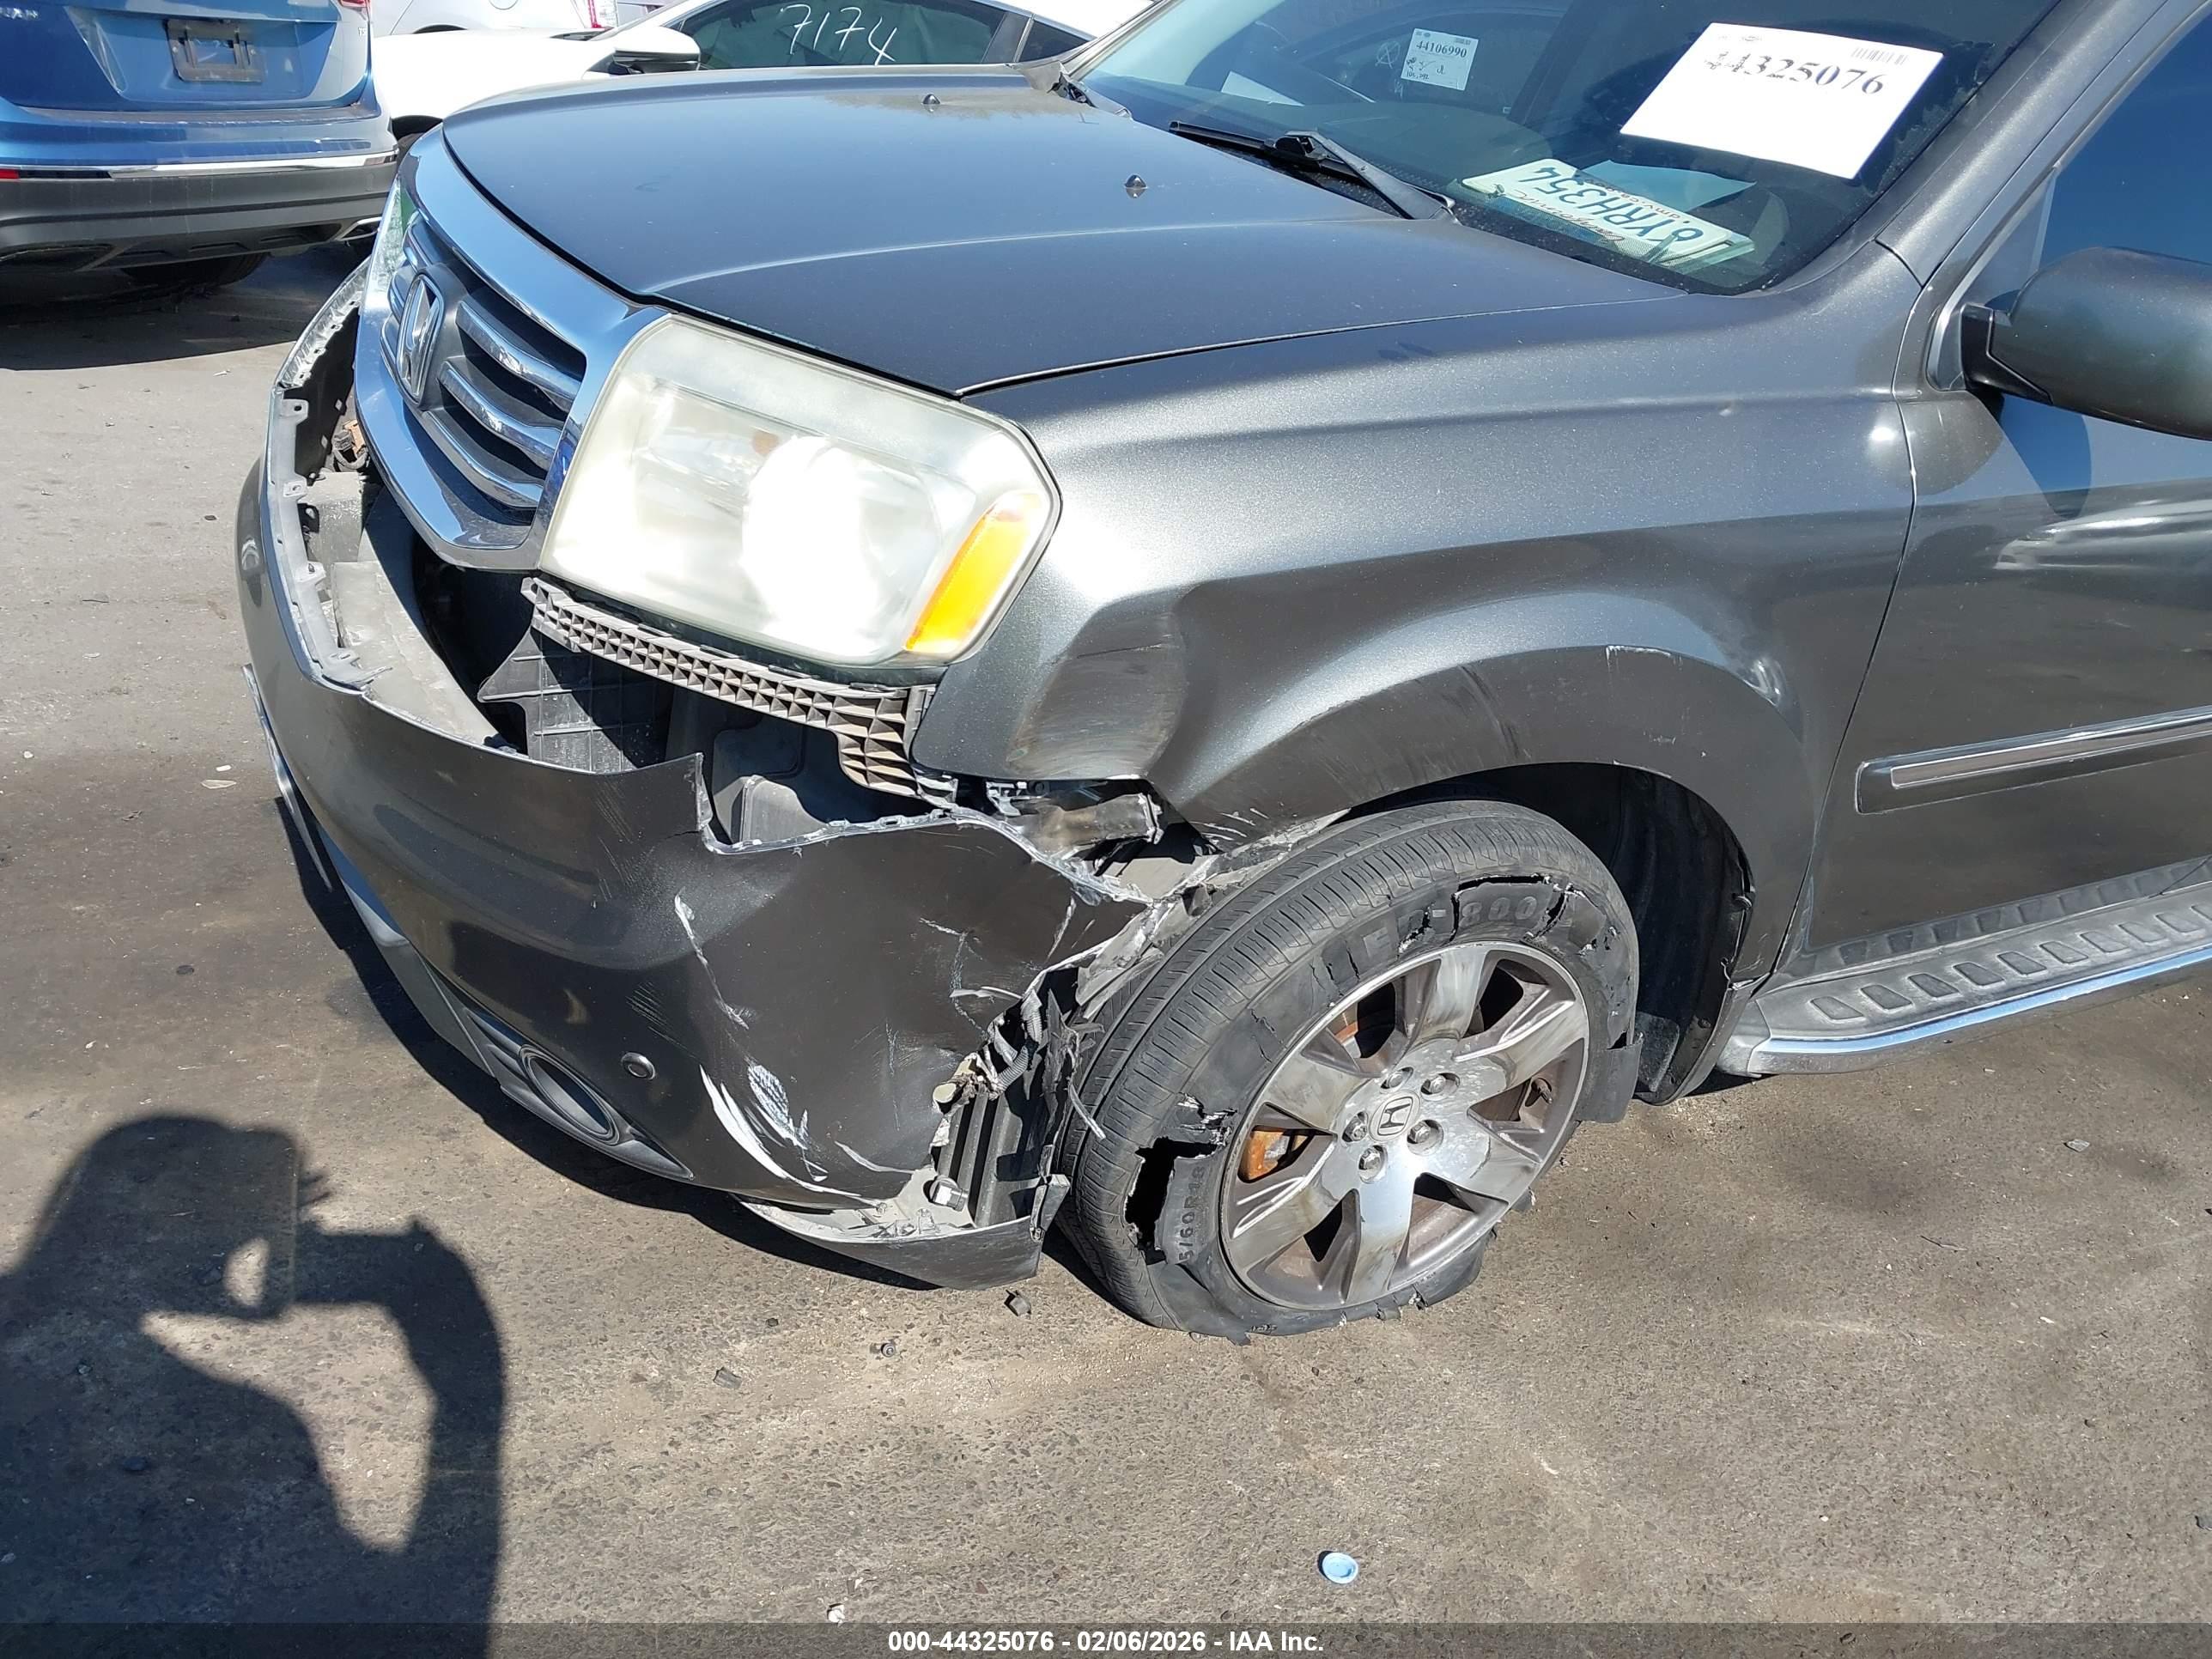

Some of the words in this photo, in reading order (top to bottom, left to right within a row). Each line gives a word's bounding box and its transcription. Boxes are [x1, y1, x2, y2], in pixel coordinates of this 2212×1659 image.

[781, 4, 897, 66] 7174
[1416, 40, 1468, 58] 44106990
[1518, 166, 1705, 242] 6YRH354
